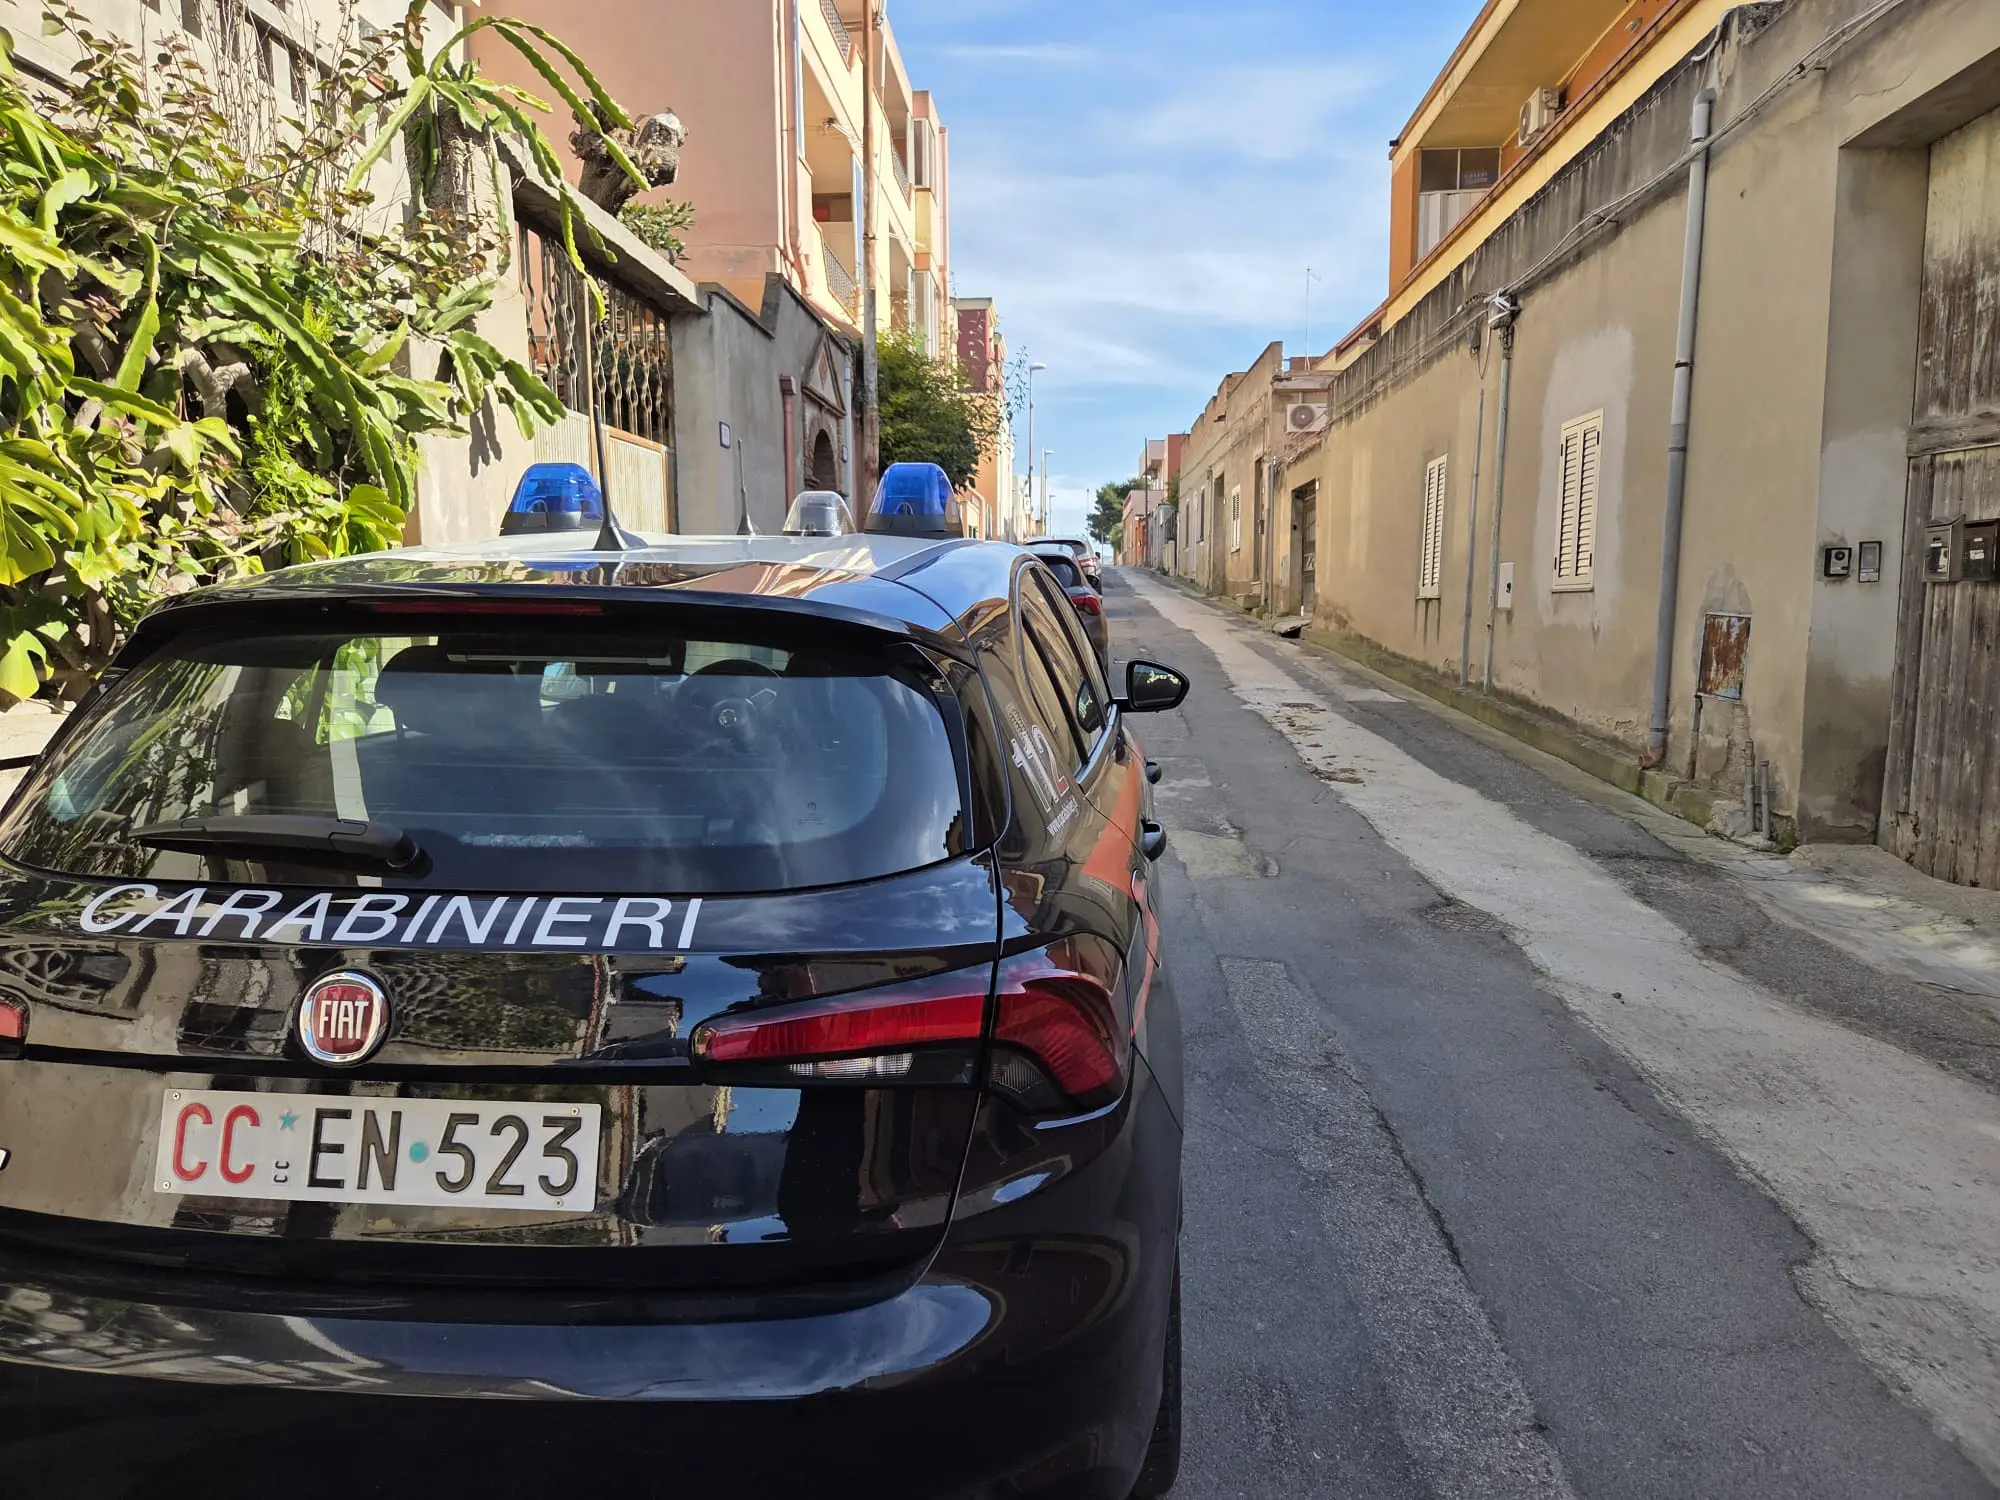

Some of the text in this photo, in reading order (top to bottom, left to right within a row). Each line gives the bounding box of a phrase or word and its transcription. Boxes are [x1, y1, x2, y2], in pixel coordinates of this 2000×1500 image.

[79, 883, 702, 949] CARABINIERI
[318, 998, 369, 1040] FIAT
[171, 1102, 582, 1198] CC EN 523
